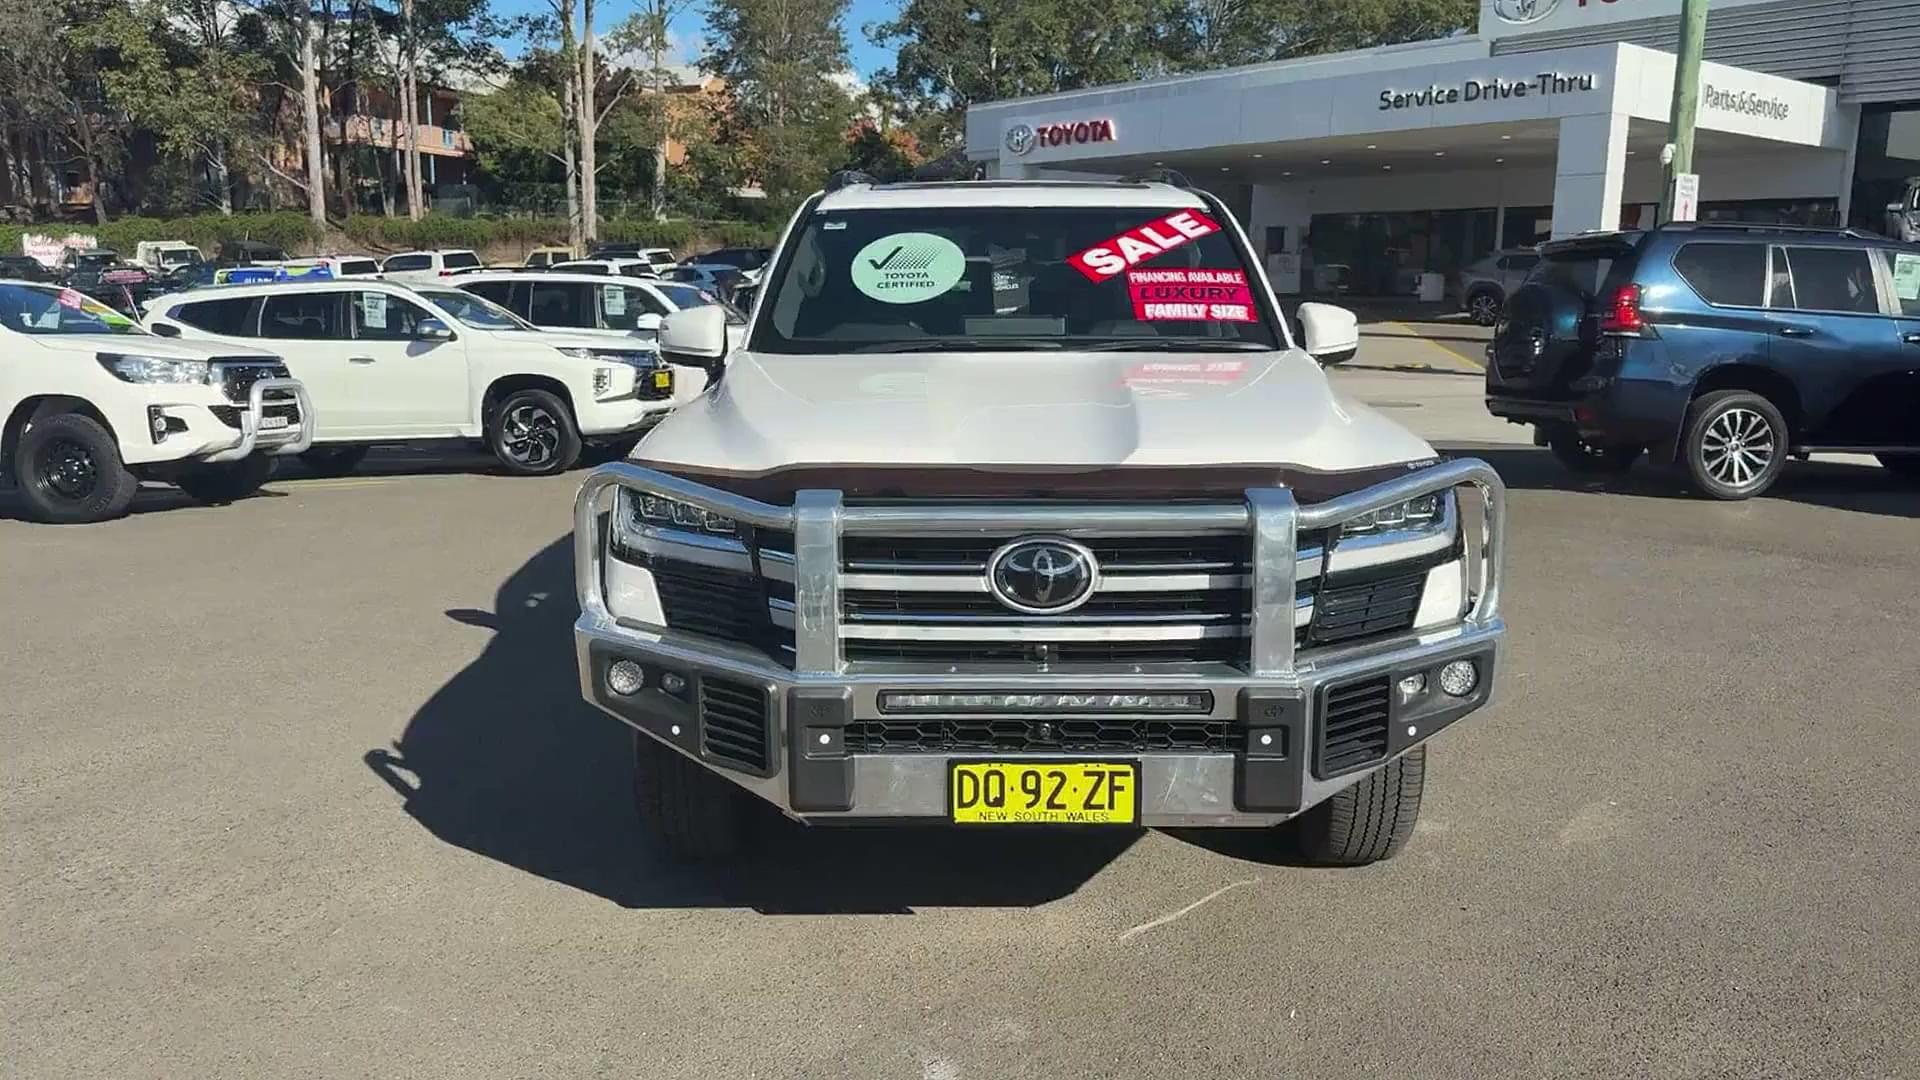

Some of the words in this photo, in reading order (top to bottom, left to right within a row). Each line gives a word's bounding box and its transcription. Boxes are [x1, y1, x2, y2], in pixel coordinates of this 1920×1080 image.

[1379, 84, 1458, 110] Service
[1464, 72, 1593, 101] Drive-Thru
[1705, 84, 1737, 110] Parts
[1748, 93, 1790, 119] Service
[1037, 119, 1114, 147] TOYOTA
[1082, 212, 1212, 275] SALE
[877, 281, 935, 289] CERTIFIED
[1130, 271, 1187, 283] FINANCING
[1188, 272, 1243, 284] AVAILABLE
[1140, 287, 1239, 299] LUXURY
[1144, 303, 1206, 319] FAMILY
[1210, 304, 1248, 320] SIZE
[979, 812, 1007, 821] NEW
[1014, 812, 1058, 821] SOUTH
[1065, 812, 1109, 821] WALES
